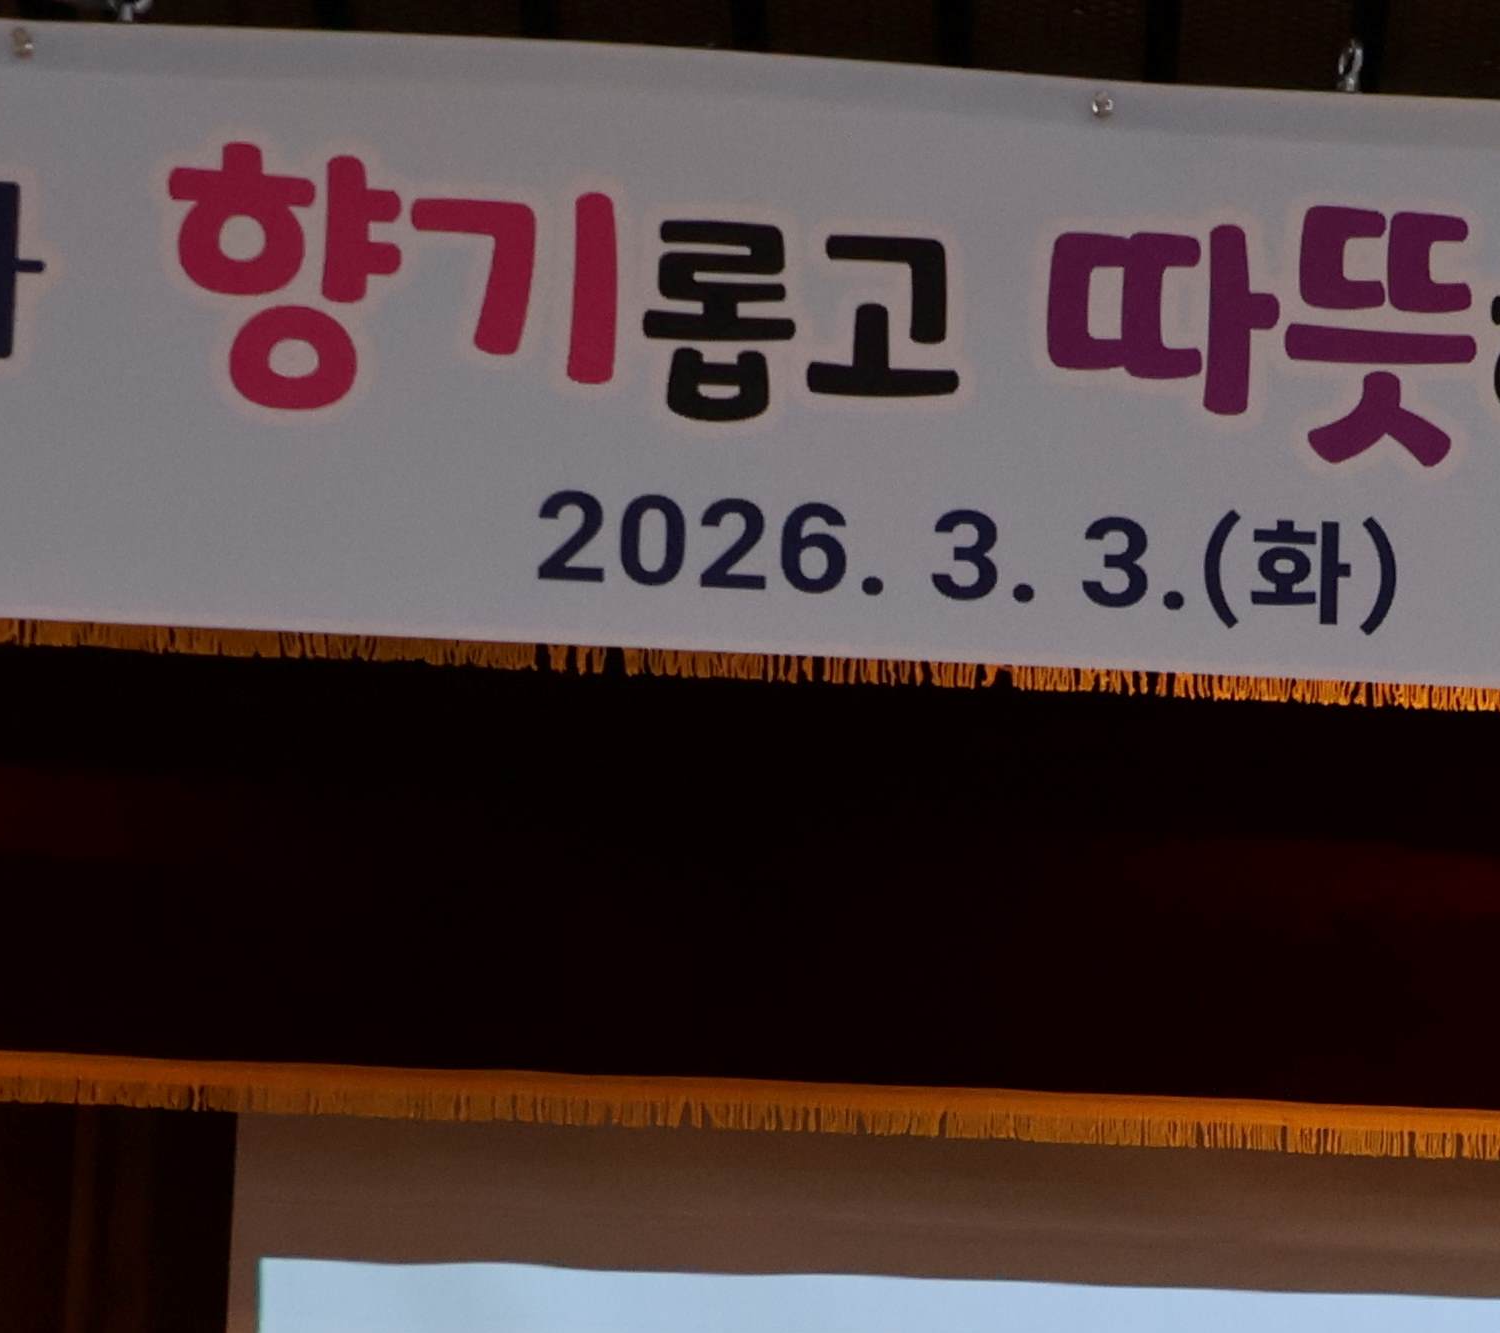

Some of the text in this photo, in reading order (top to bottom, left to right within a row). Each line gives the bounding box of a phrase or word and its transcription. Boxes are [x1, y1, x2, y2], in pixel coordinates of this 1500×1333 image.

[169, 143, 960, 422] 향기롭고
[537, 490, 884, 596] 2026.
[931, 509, 1035, 603] 3.
[1082, 509, 1398, 636] 3.(화)
